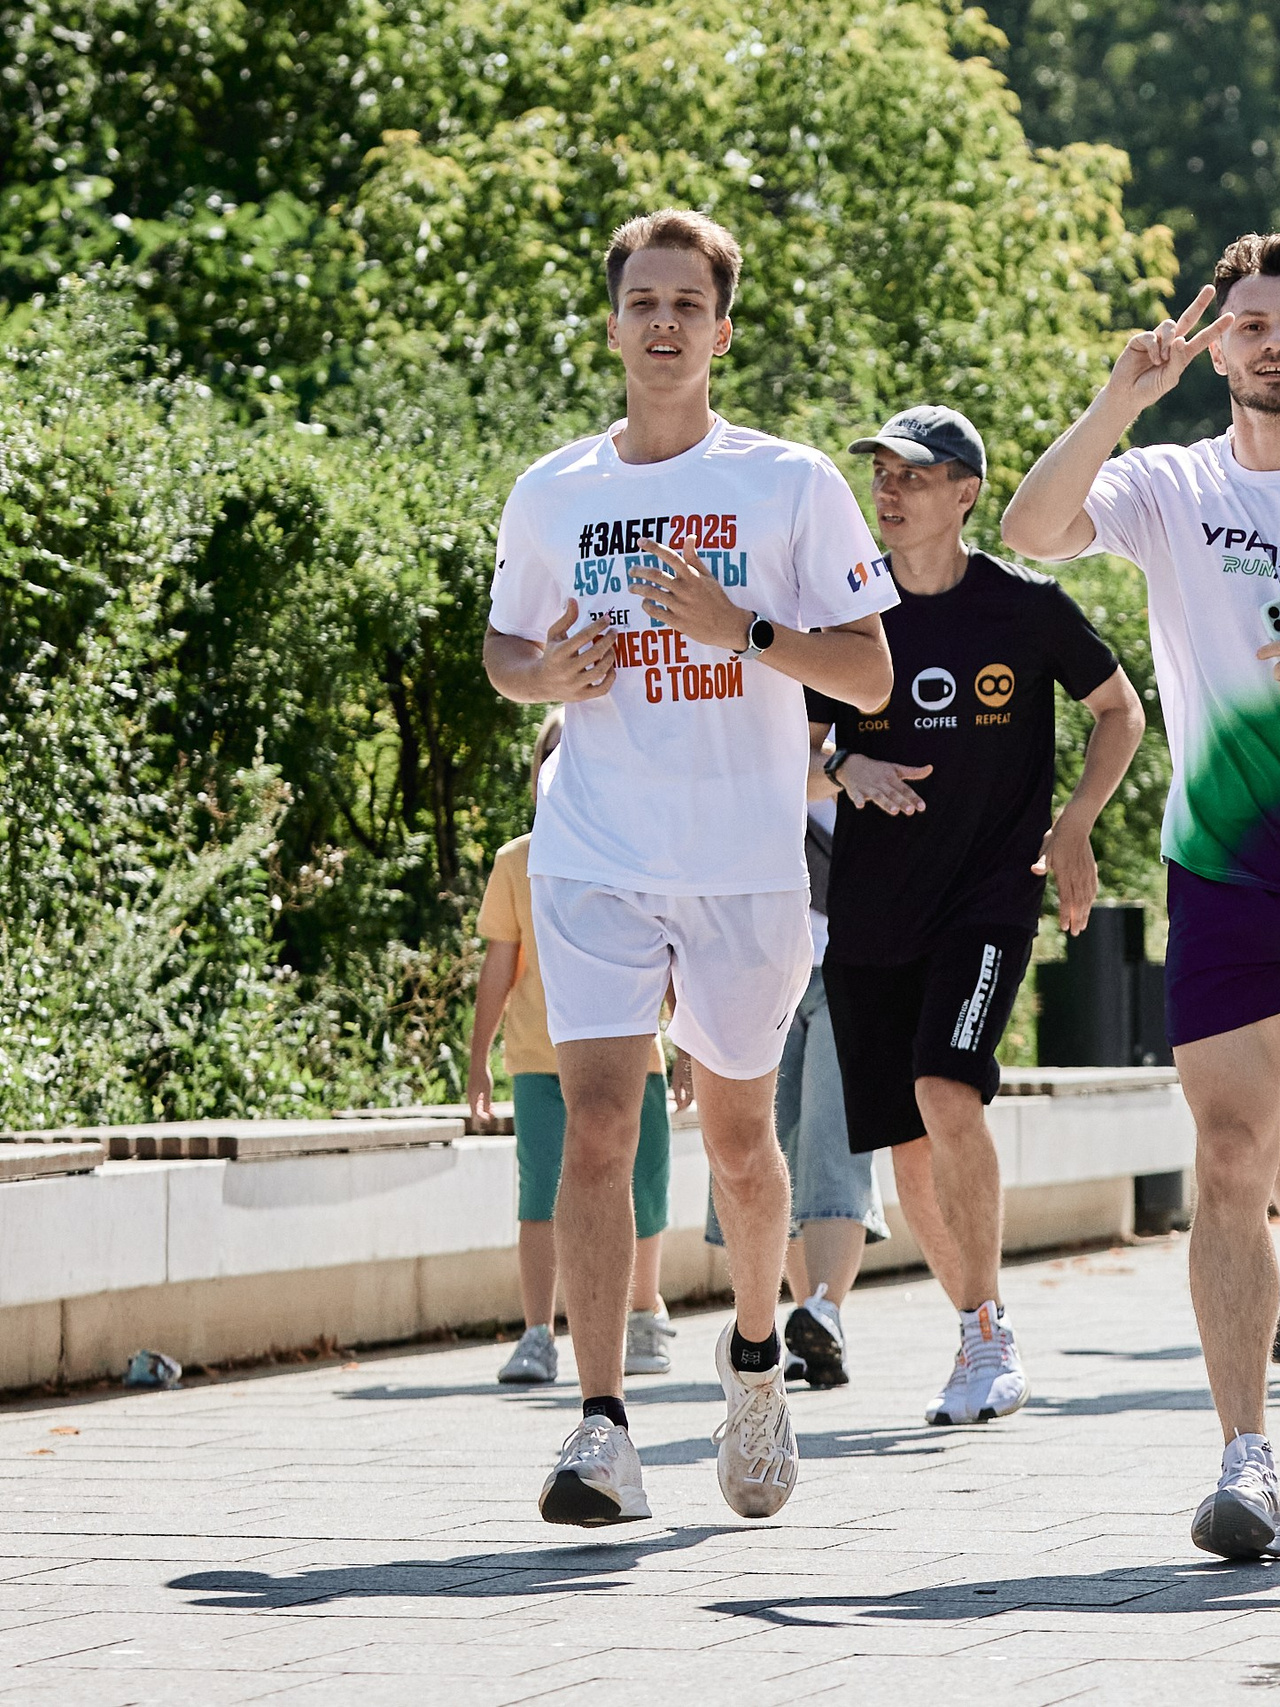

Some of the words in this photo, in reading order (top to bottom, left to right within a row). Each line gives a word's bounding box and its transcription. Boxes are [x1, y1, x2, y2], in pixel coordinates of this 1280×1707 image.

[573, 557, 622, 597] 45%
[1221, 555, 1275, 578] RUN
[592, 628, 690, 669] МЕСТЕ
[645, 667, 662, 704] С
[667, 656, 744, 703] ТОБОЙ
[858, 719, 890, 732] CODE
[914, 715, 958, 729] COFFEE
[975, 712, 1012, 726] REPEAT
[957, 943, 997, 1050] SPORTING
[950, 998, 970, 1048] COMPETITION
